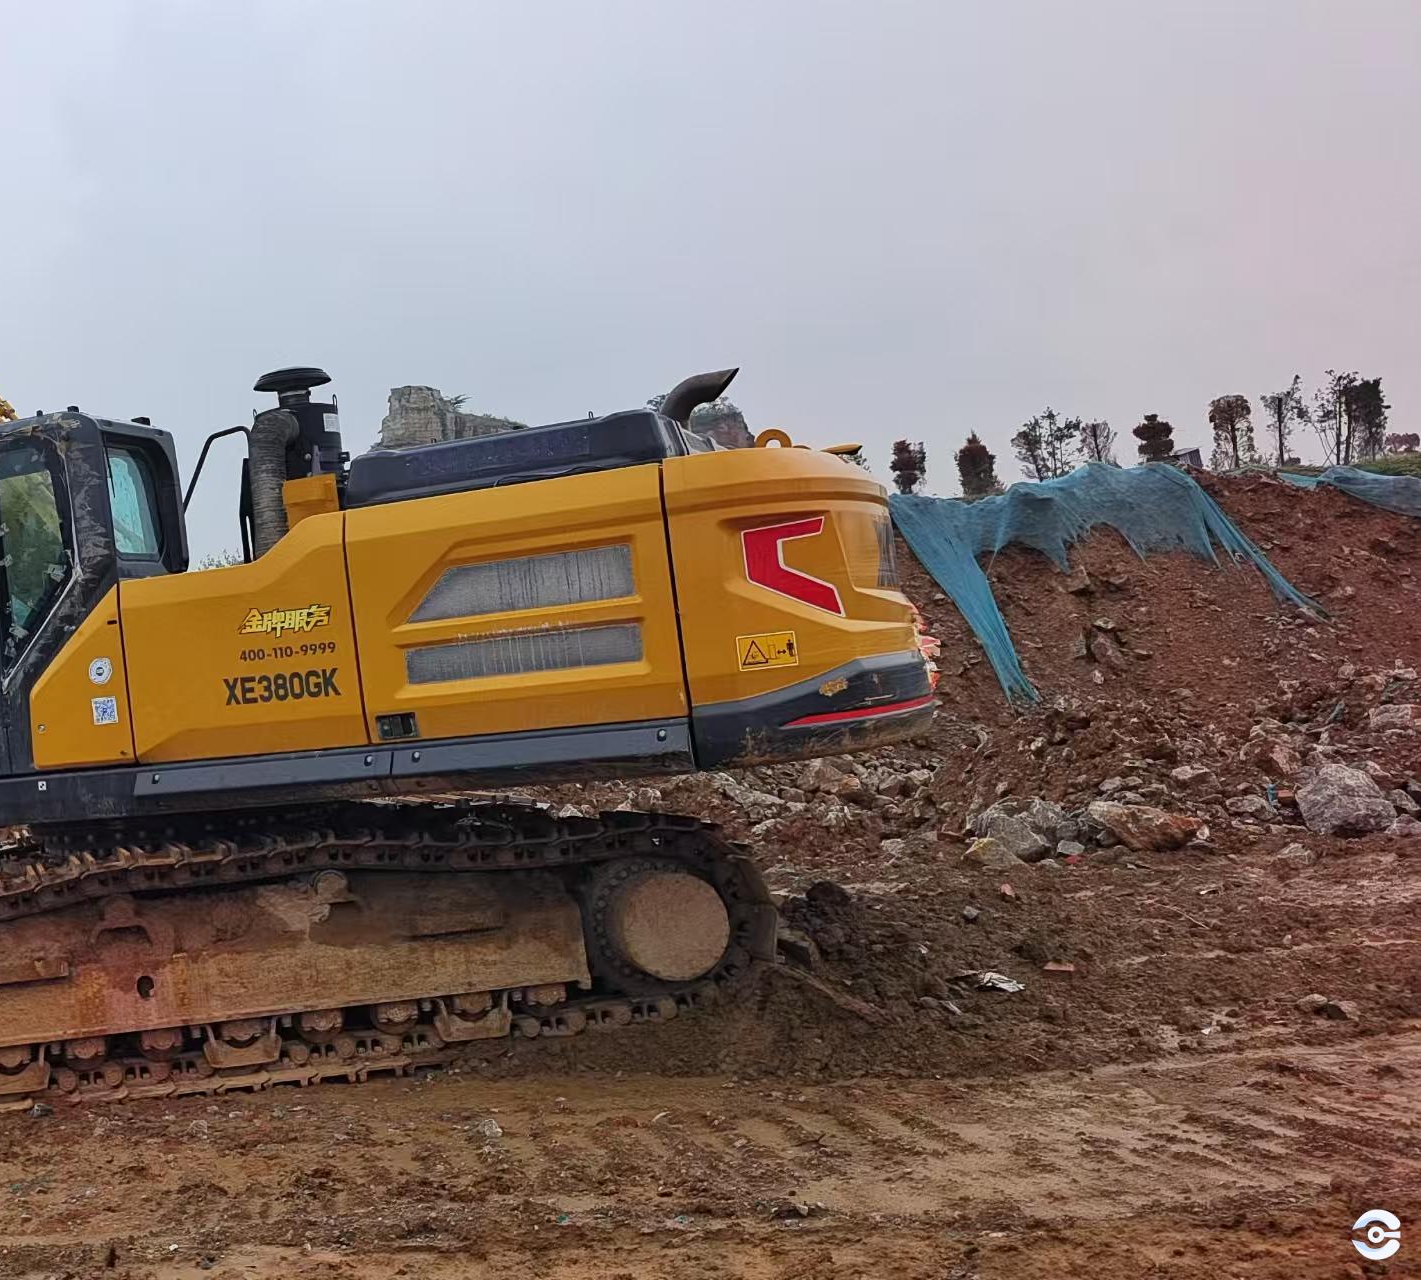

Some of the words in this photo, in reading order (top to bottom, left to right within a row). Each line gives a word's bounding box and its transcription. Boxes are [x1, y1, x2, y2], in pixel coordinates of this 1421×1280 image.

[238, 604, 331, 639] 金牌服务
[240, 641, 336, 661] 400-110-9999
[222, 667, 341, 705] XE380GK
